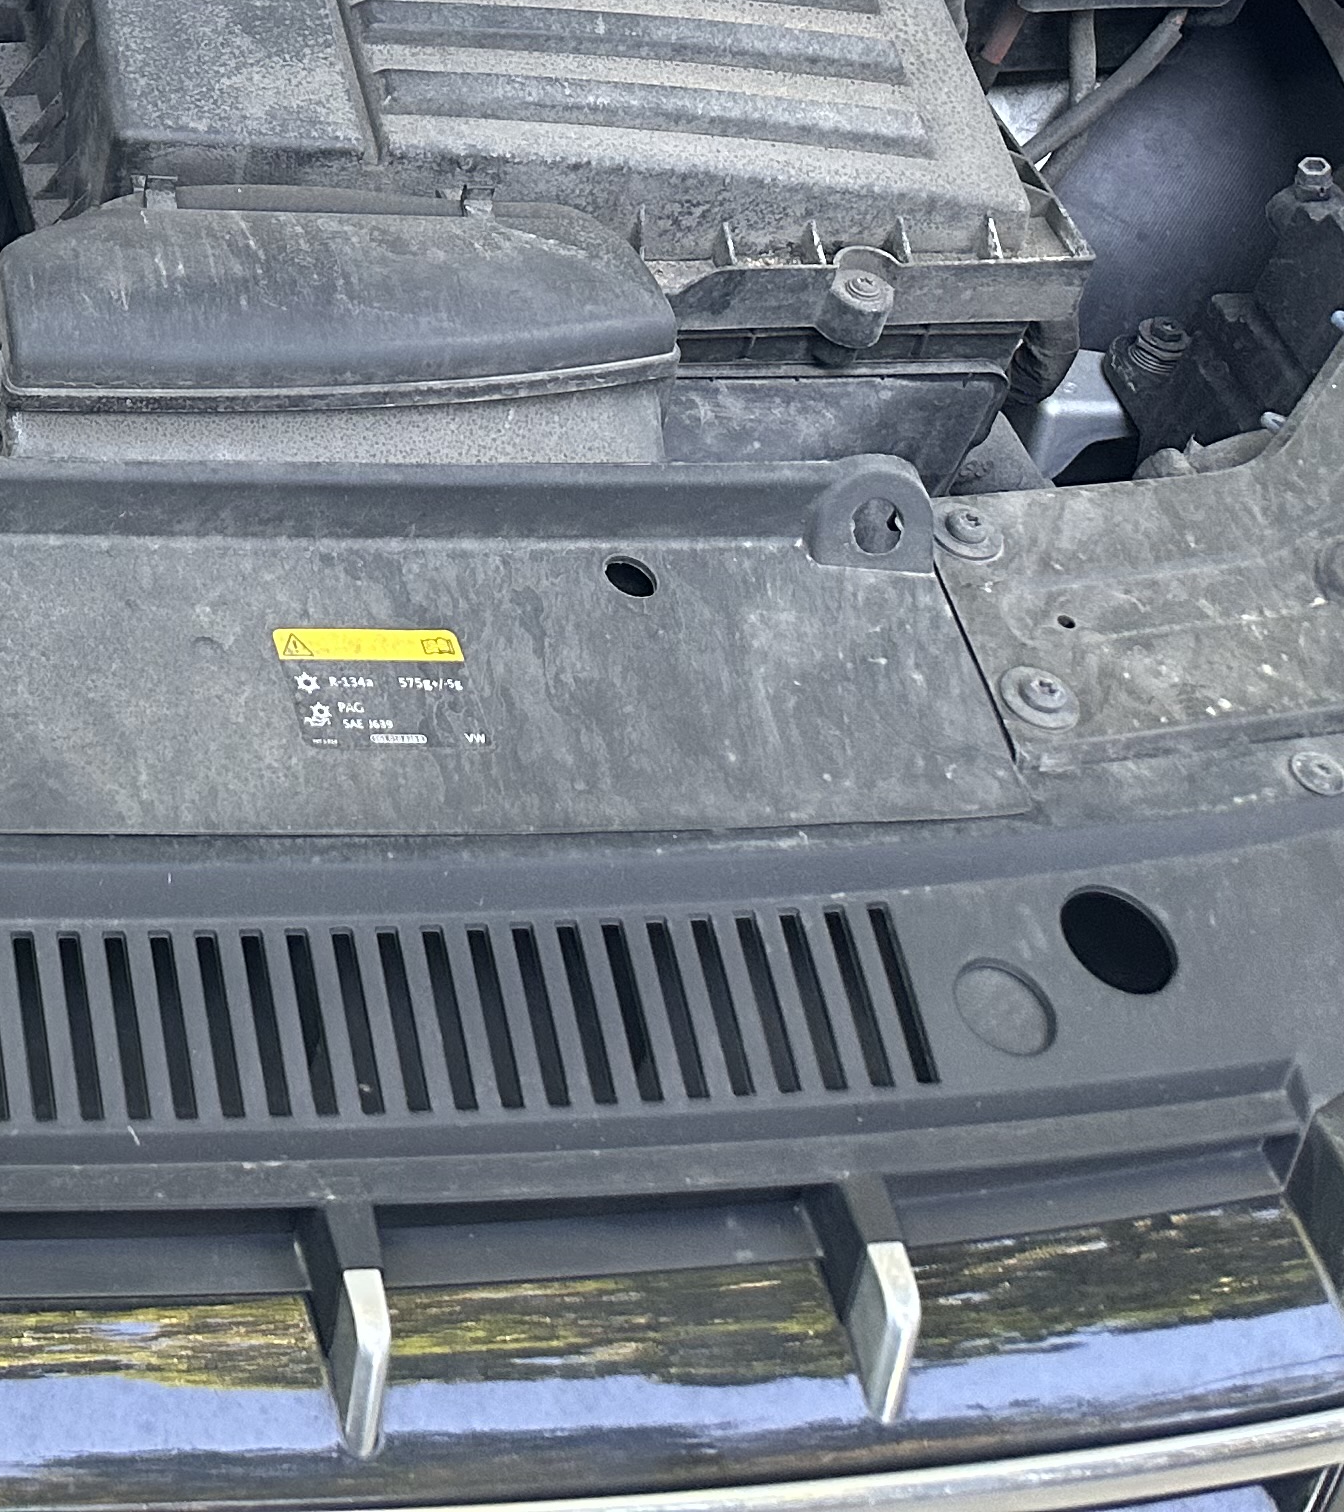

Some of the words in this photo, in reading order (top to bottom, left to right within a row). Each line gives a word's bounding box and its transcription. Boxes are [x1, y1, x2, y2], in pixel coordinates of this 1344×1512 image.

[329, 677, 374, 688] R-134a
[338, 702, 364, 713] PAG
[343, 719, 364, 729] SAE
[464, 733, 486, 743] VW
